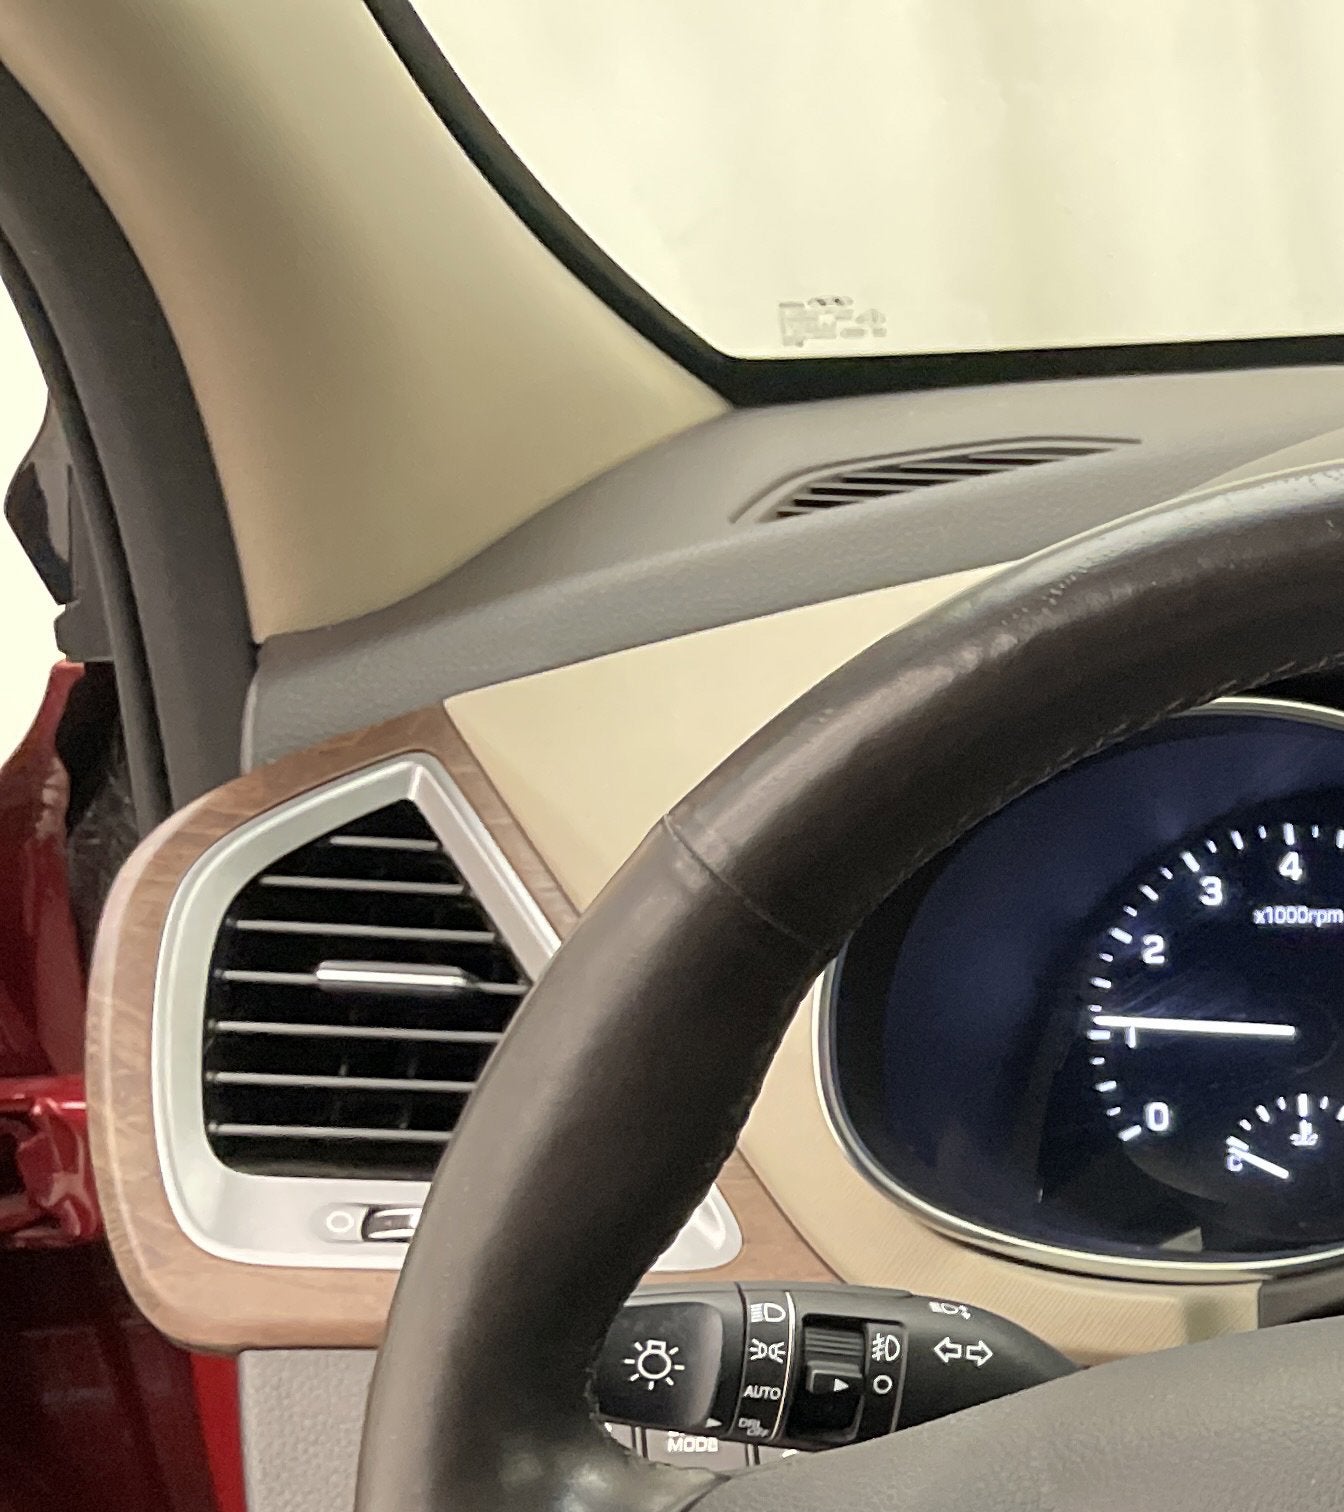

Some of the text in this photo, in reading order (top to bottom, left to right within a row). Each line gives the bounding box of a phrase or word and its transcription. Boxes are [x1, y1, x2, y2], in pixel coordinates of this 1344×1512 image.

[1279, 852, 1303, 881] 4
[1200, 876, 1223, 906] 3
[1253, 906, 1344, 927] x1000rpm
[1142, 934, 1165, 964] 2
[1144, 1102, 1169, 1131] 0
[743, 1385, 781, 1400] AUTO
